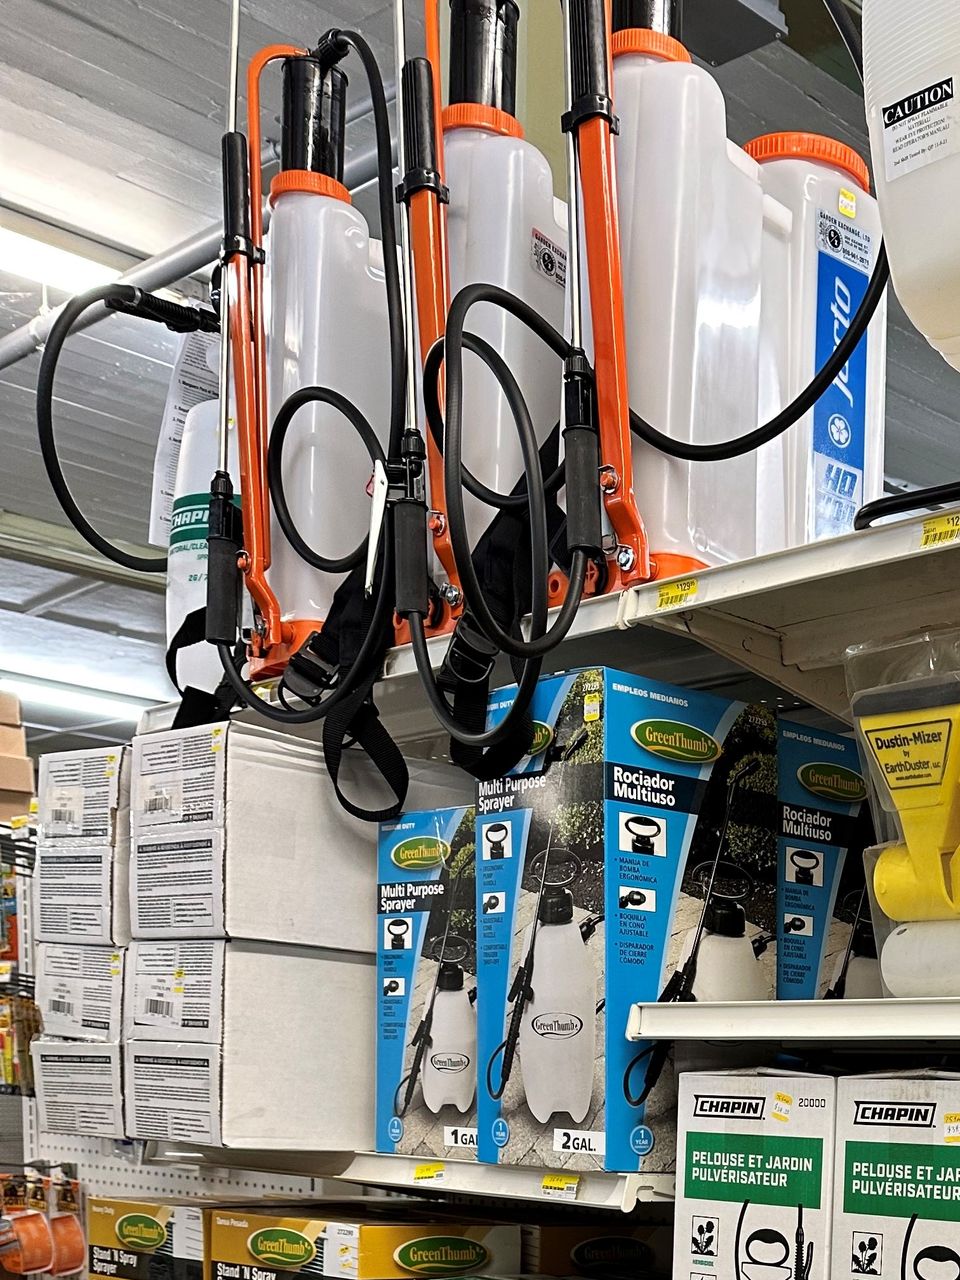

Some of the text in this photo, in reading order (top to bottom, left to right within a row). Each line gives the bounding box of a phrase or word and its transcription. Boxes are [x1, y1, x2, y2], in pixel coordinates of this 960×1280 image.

[883, 80, 953, 125] CAUTION
[612, 683, 688, 708] EMPLEOS MEDIANOS
[645, 726, 708, 754] GreenThumb
[875, 731, 942, 750] Dustin-Mizer
[903, 750, 910, 758] by
[478, 775, 546, 798] Multi Purpose
[613, 766, 675, 791] Rociador
[478, 795, 514, 814] Sprayer
[613, 782, 676, 808] Multiuso
[381, 882, 444, 899] Multi Purpose
[381, 896, 416, 912] Sprayer
[699, 1099, 760, 1115] CHAPIN
[798, 1098, 826, 1108] 20000
[562, 1131, 597, 1152] 2 GAL.
[692, 1151, 813, 1172] PELOUSE ET JARDIN
[692, 1166, 787, 1187] PULVÉRISATEUR
[257, 1237, 306, 1254] GreenThumb
[217, 1263, 240, 1280] Stand
